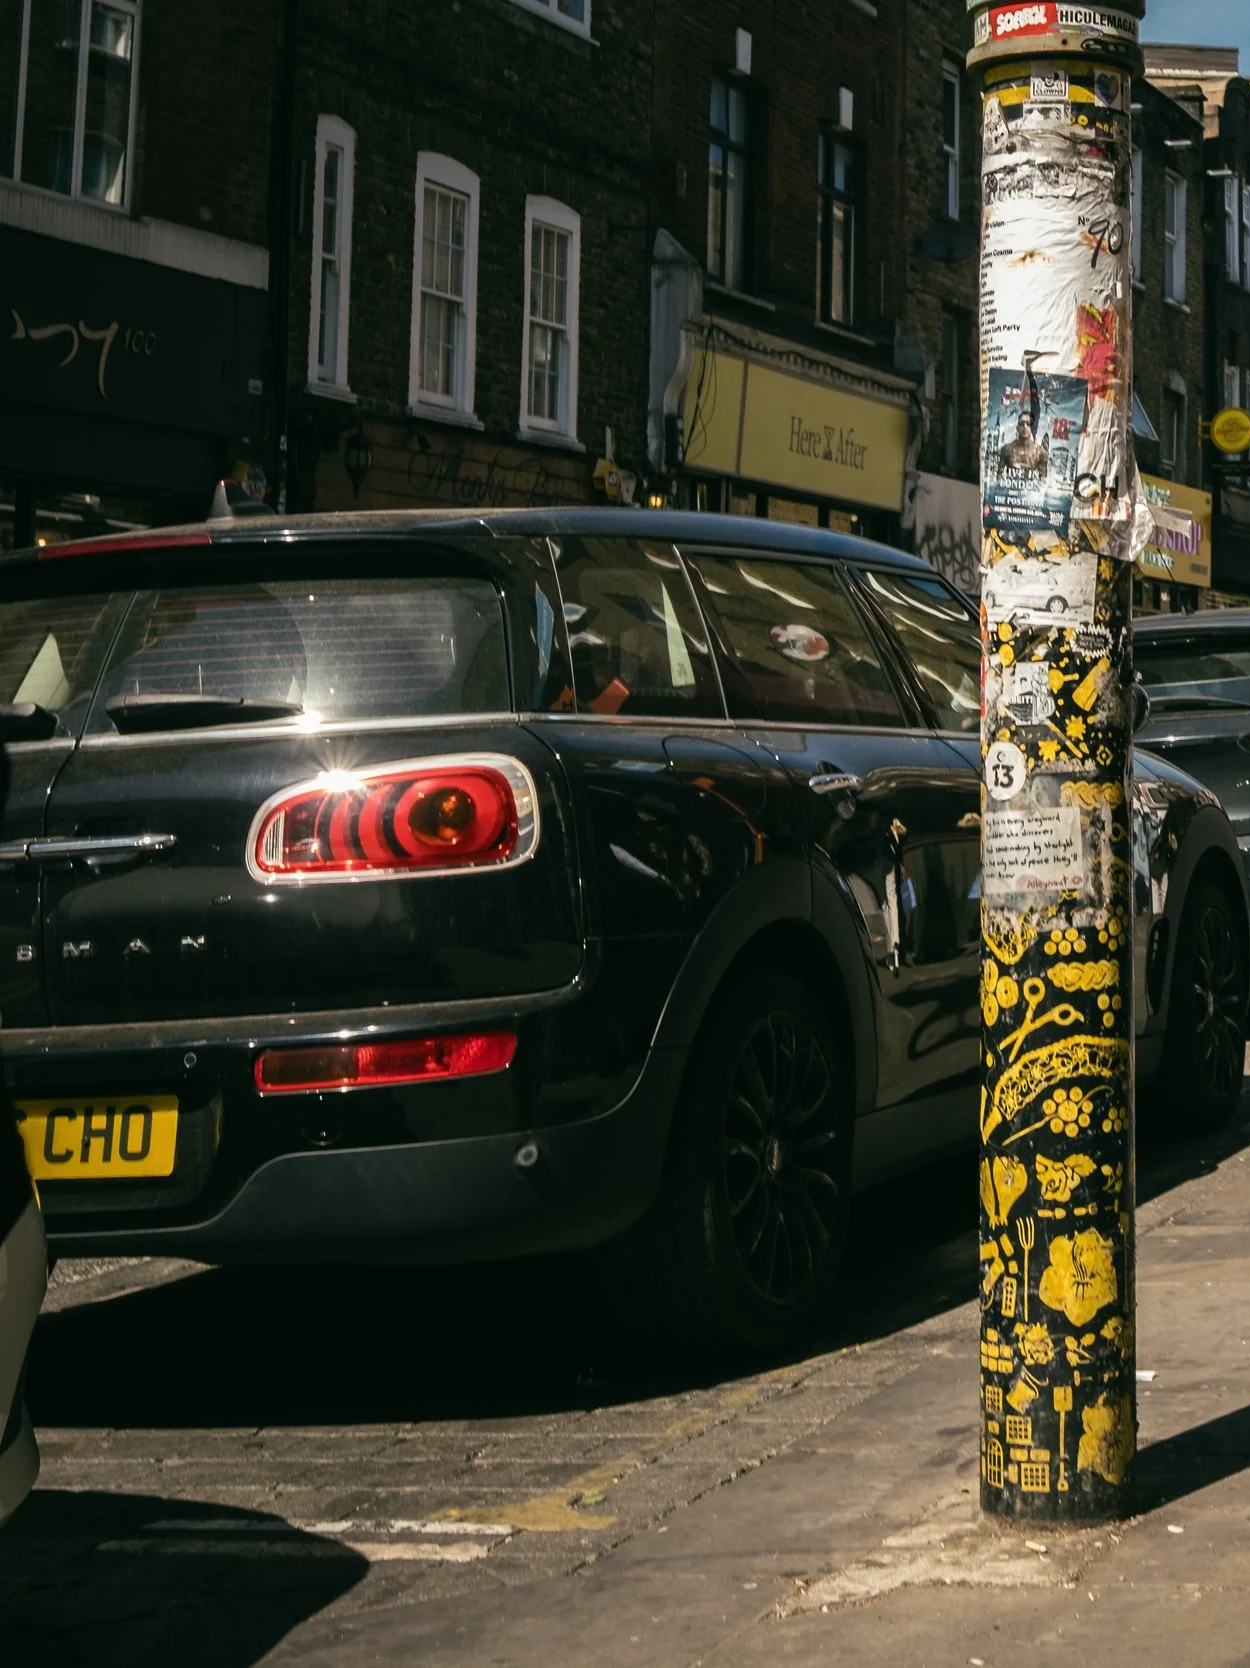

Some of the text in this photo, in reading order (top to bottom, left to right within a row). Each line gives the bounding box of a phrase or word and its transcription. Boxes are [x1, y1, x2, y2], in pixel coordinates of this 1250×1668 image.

[1003, 324, 1020, 332] Party
[123, 328, 157, 357] 100
[789, 415, 868, 471] Here After
[992, 764, 1014, 788] 13
[1027, 812, 1061, 827] wayward
[1022, 829, 1053, 837] discovers
[1044, 837, 1073, 852] starlight
[1028, 857, 1049, 869] peace
[1053, 852, 1078, 867] they'll
